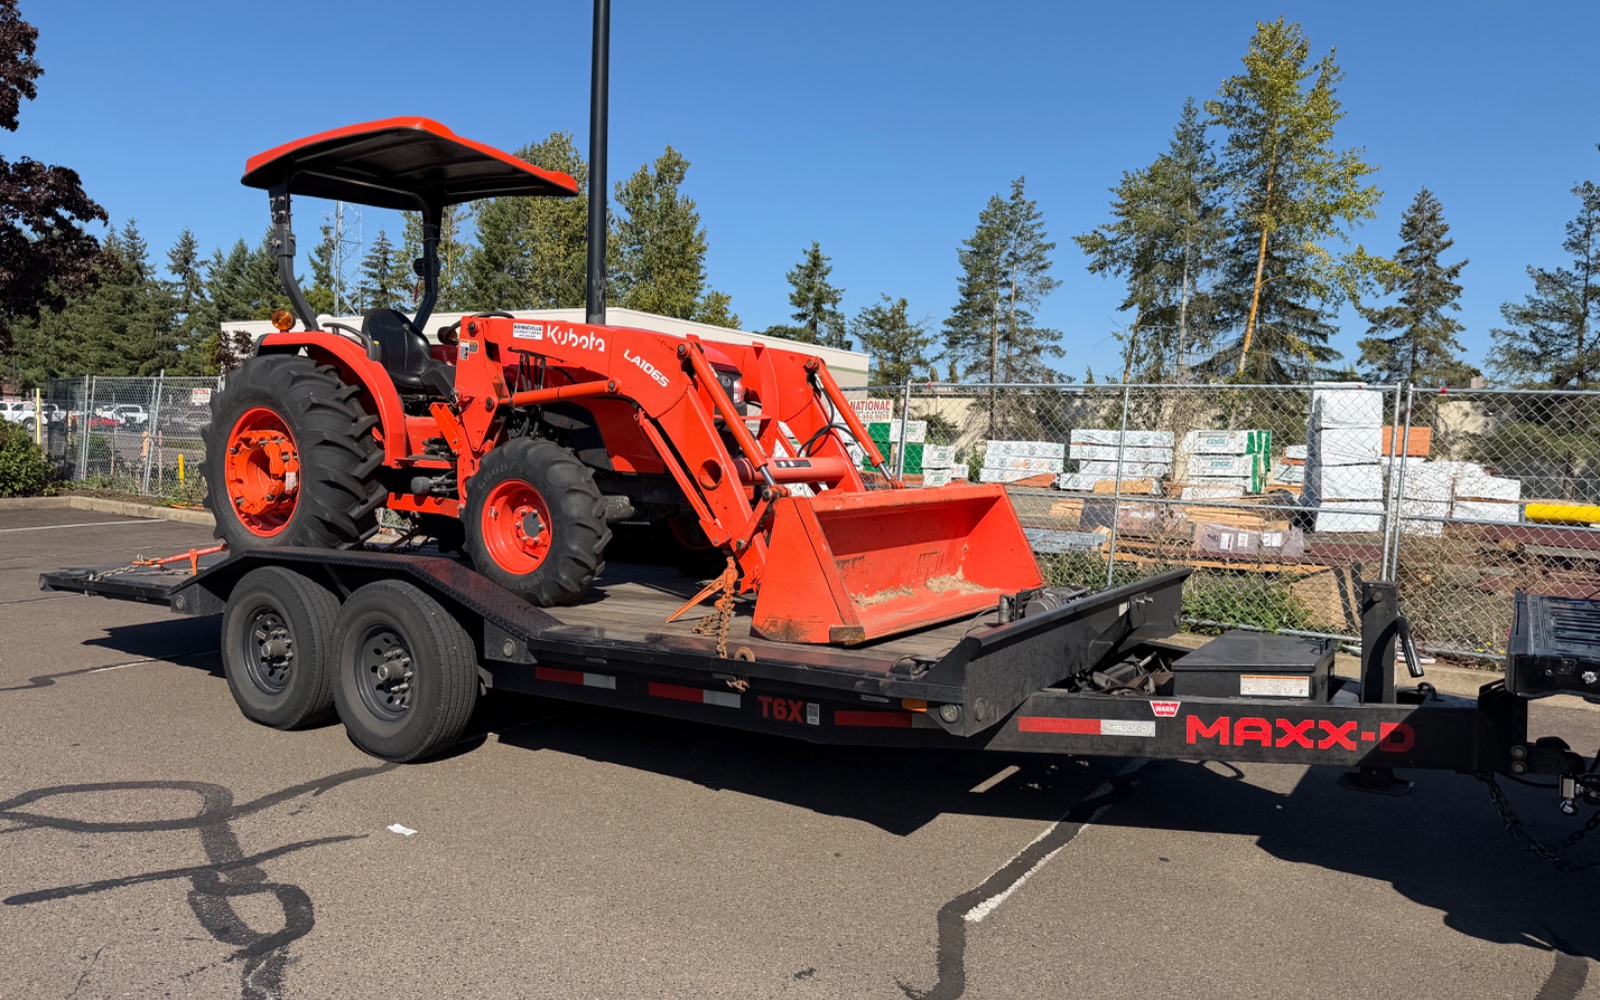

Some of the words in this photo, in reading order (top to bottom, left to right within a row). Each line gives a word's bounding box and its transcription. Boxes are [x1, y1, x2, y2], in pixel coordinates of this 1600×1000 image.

[546, 324, 605, 353] Kubota
[623, 349, 670, 388] LA1065
[849, 400, 891, 411] NATIONAL
[758, 695, 805, 724] T6X
[1155, 705, 1175, 713] WARN
[1186, 715, 1415, 752] MAXX-D
